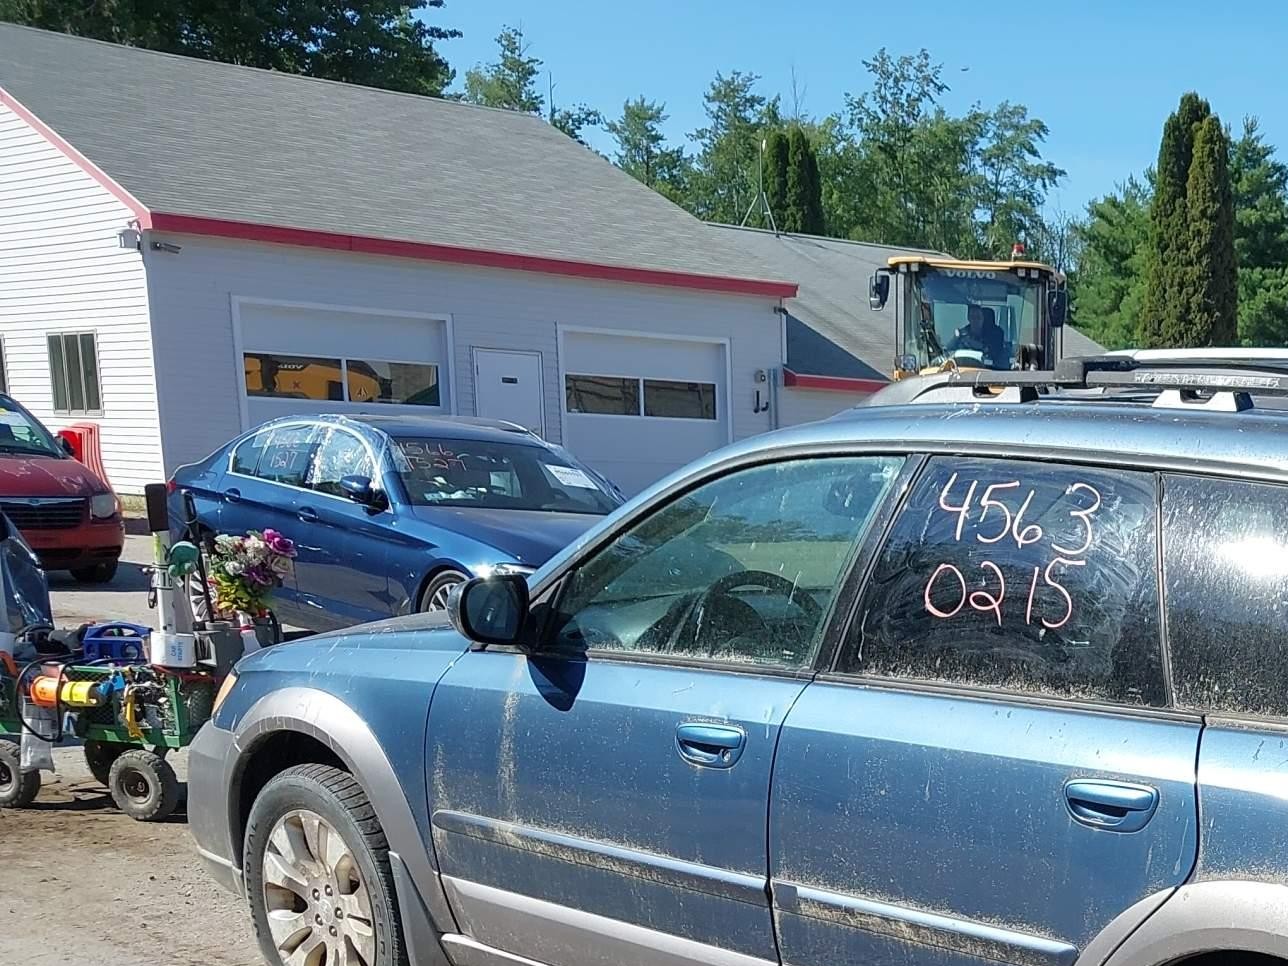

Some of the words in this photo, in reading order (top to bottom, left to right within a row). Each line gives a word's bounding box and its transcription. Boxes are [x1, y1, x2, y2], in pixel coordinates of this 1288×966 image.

[945, 270, 996, 280] VOLVO
[939, 472, 1101, 555] 4563
[924, 556, 1087, 628] 0215
